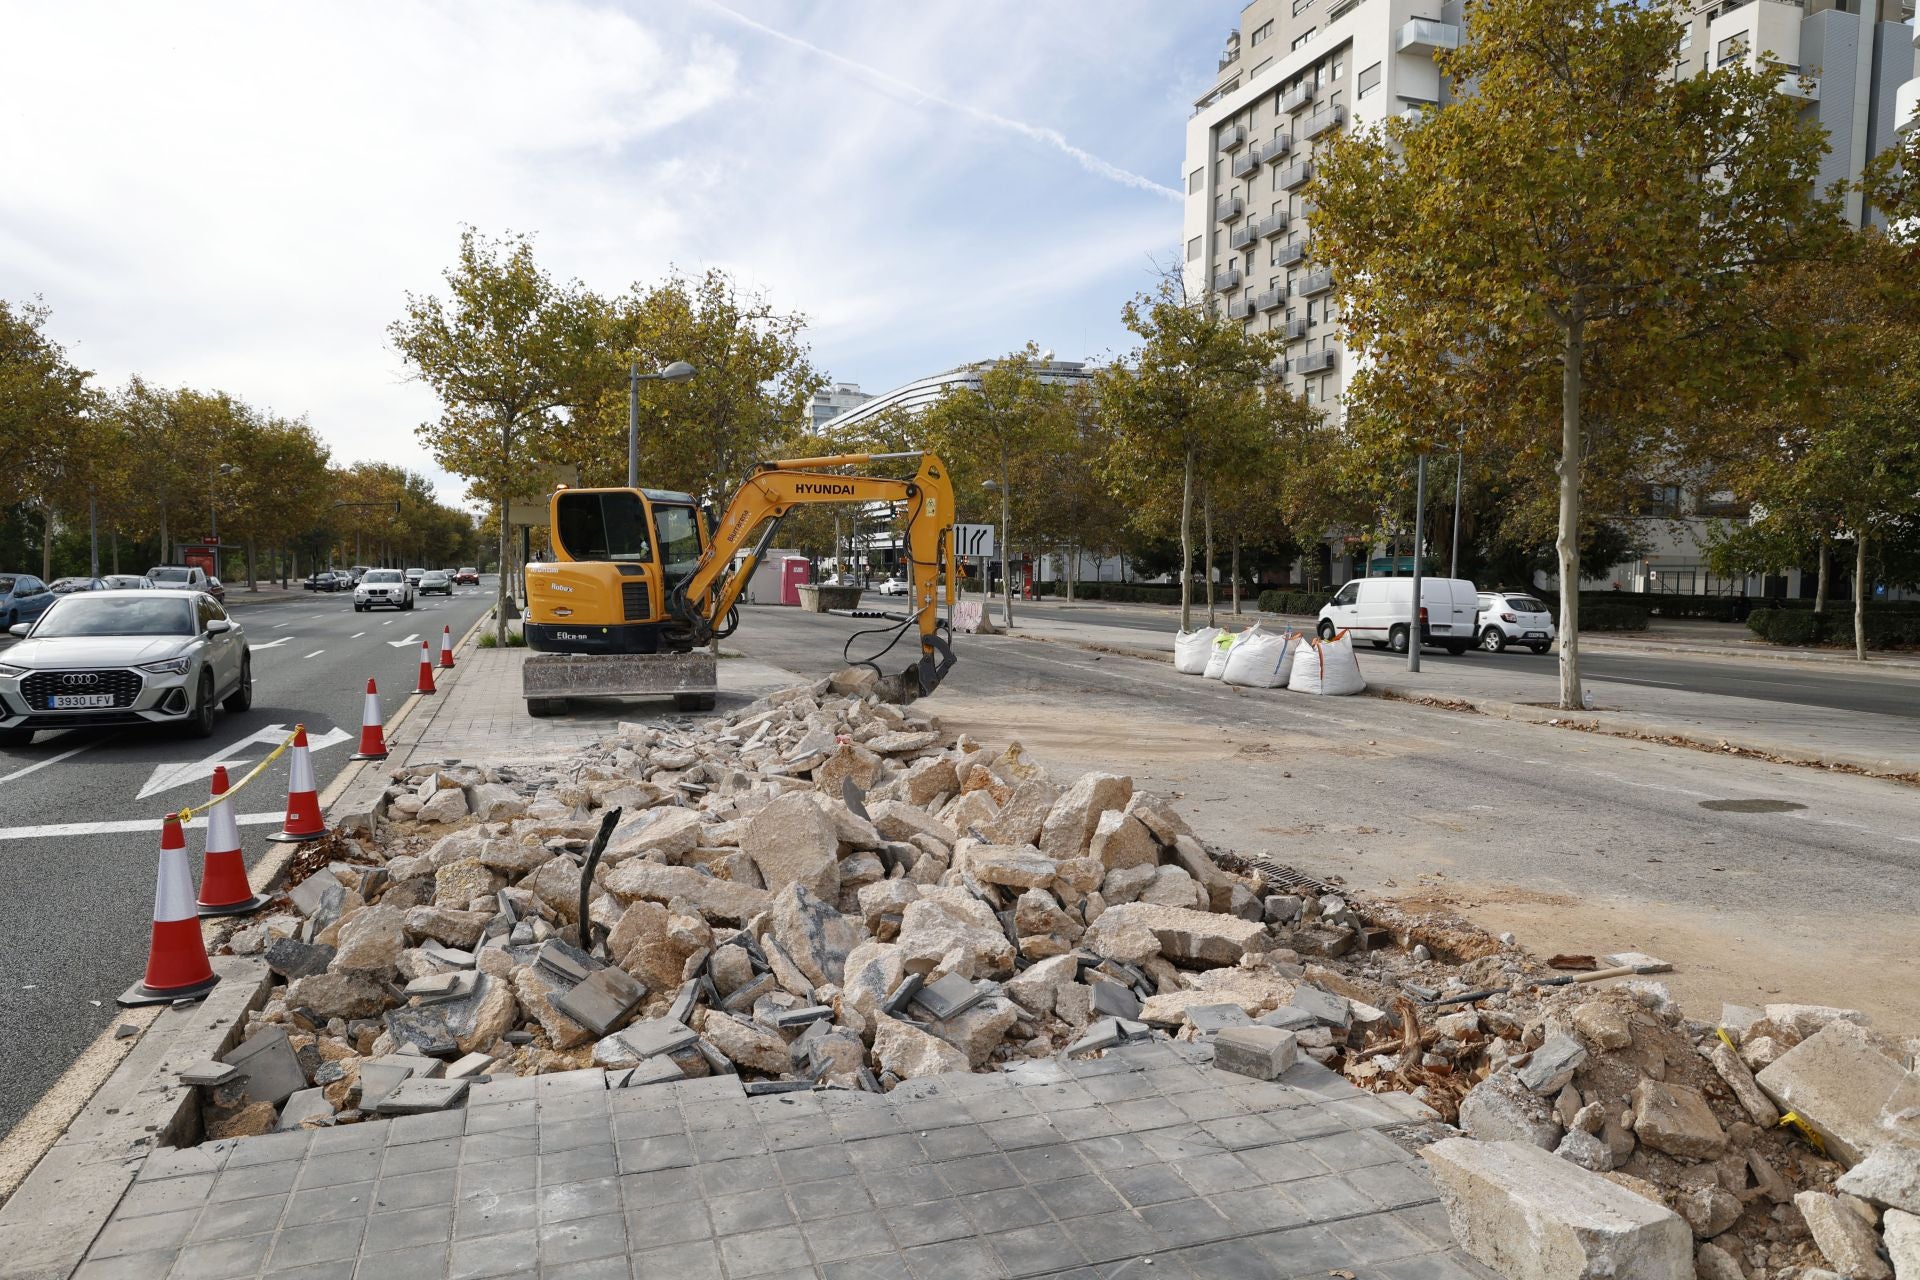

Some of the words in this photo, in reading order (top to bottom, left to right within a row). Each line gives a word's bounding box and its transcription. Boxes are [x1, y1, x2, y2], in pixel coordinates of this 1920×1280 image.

[795, 483, 855, 495] HYUNDAI
[551, 583, 573, 593] Robex
[57, 696, 86, 706] 3930
[89, 695, 111, 705] LFV
